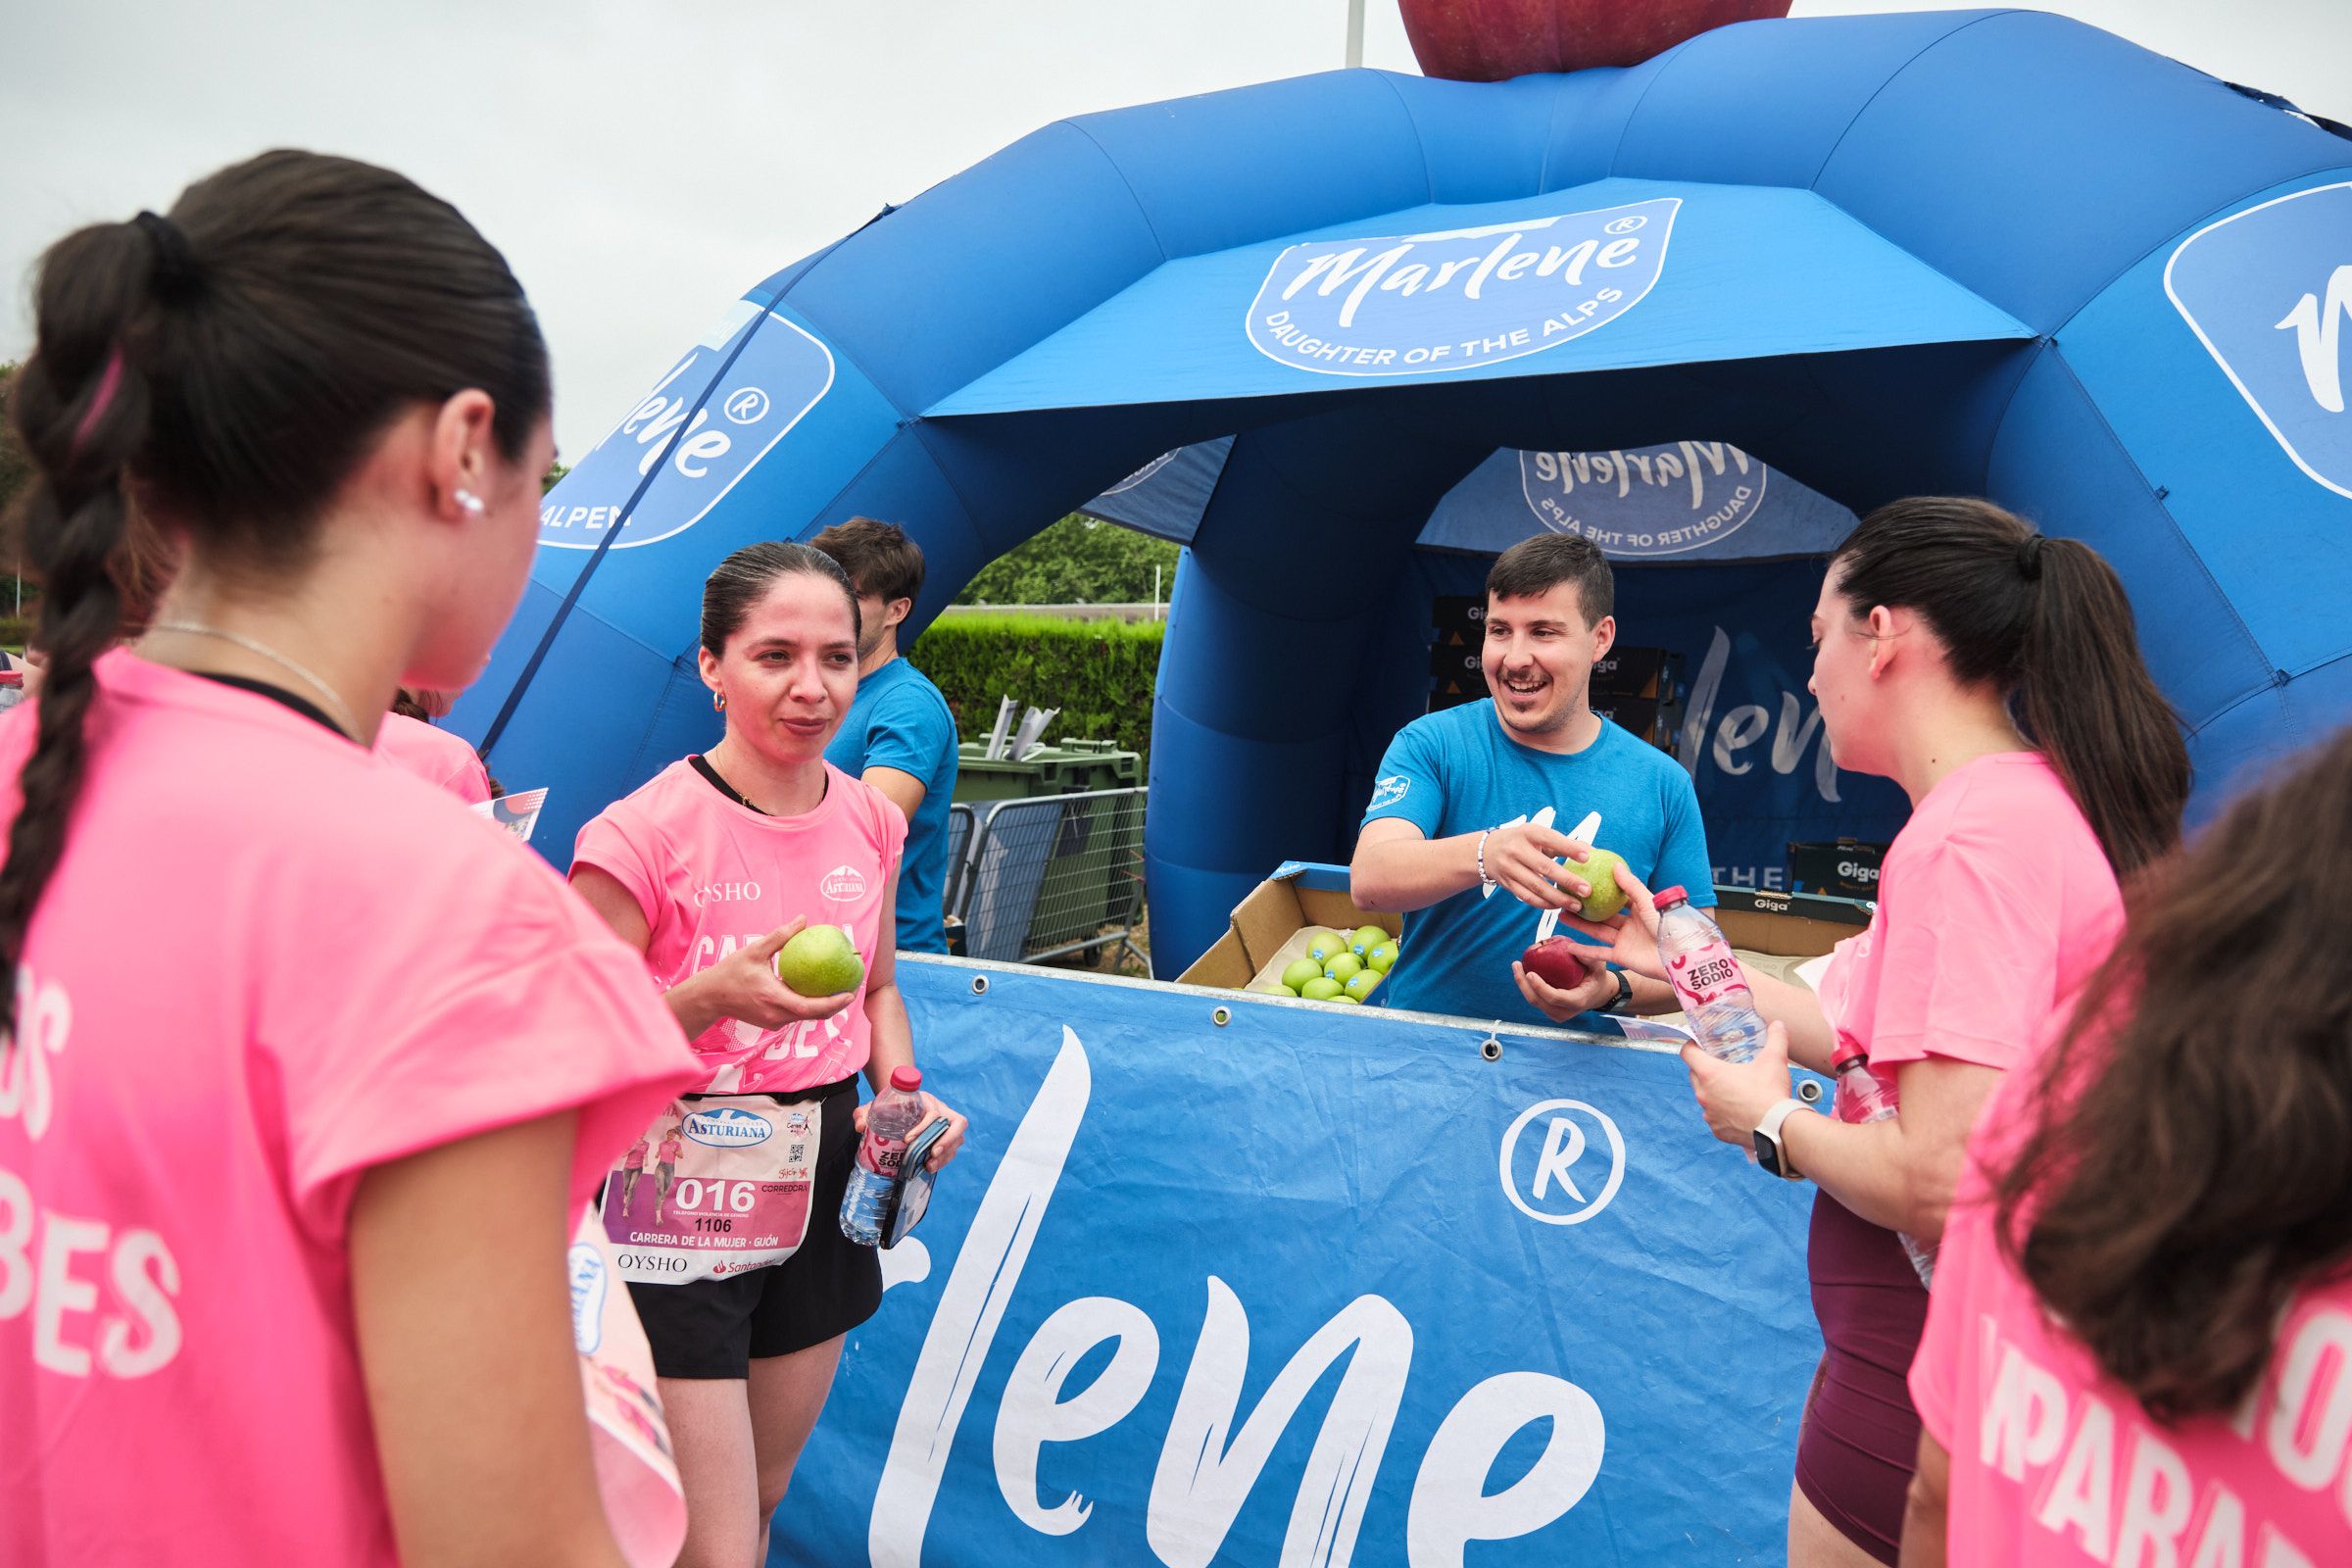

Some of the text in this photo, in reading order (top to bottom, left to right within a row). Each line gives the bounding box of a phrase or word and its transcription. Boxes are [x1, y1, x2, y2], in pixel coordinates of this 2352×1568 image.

[1282, 232, 1641, 328] Marlene
[1265, 287, 1624, 366] DAUGHTER OF THE ALPS
[1467, 606, 1488, 620] Gi
[1464, 656, 1482, 670] Gi
[1712, 867, 1783, 891] THE
[1837, 860, 1880, 882] Giga
[1754, 899, 1788, 911] Giga
[1687, 958, 1729, 982] ZERO
[1690, 968, 1734, 991] SODIO
[688, 1117, 766, 1139] ASTURIANA
[675, 1178, 756, 1212] 016
[760, 1184, 808, 1193] CORREDORA
[694, 1218, 732, 1233] 1106
[629, 1231, 779, 1249] CARRERA DE LA MUJER GIJÓN
[617, 1253, 687, 1273] OYSHO
[868, 1024, 1605, 1568] lene
